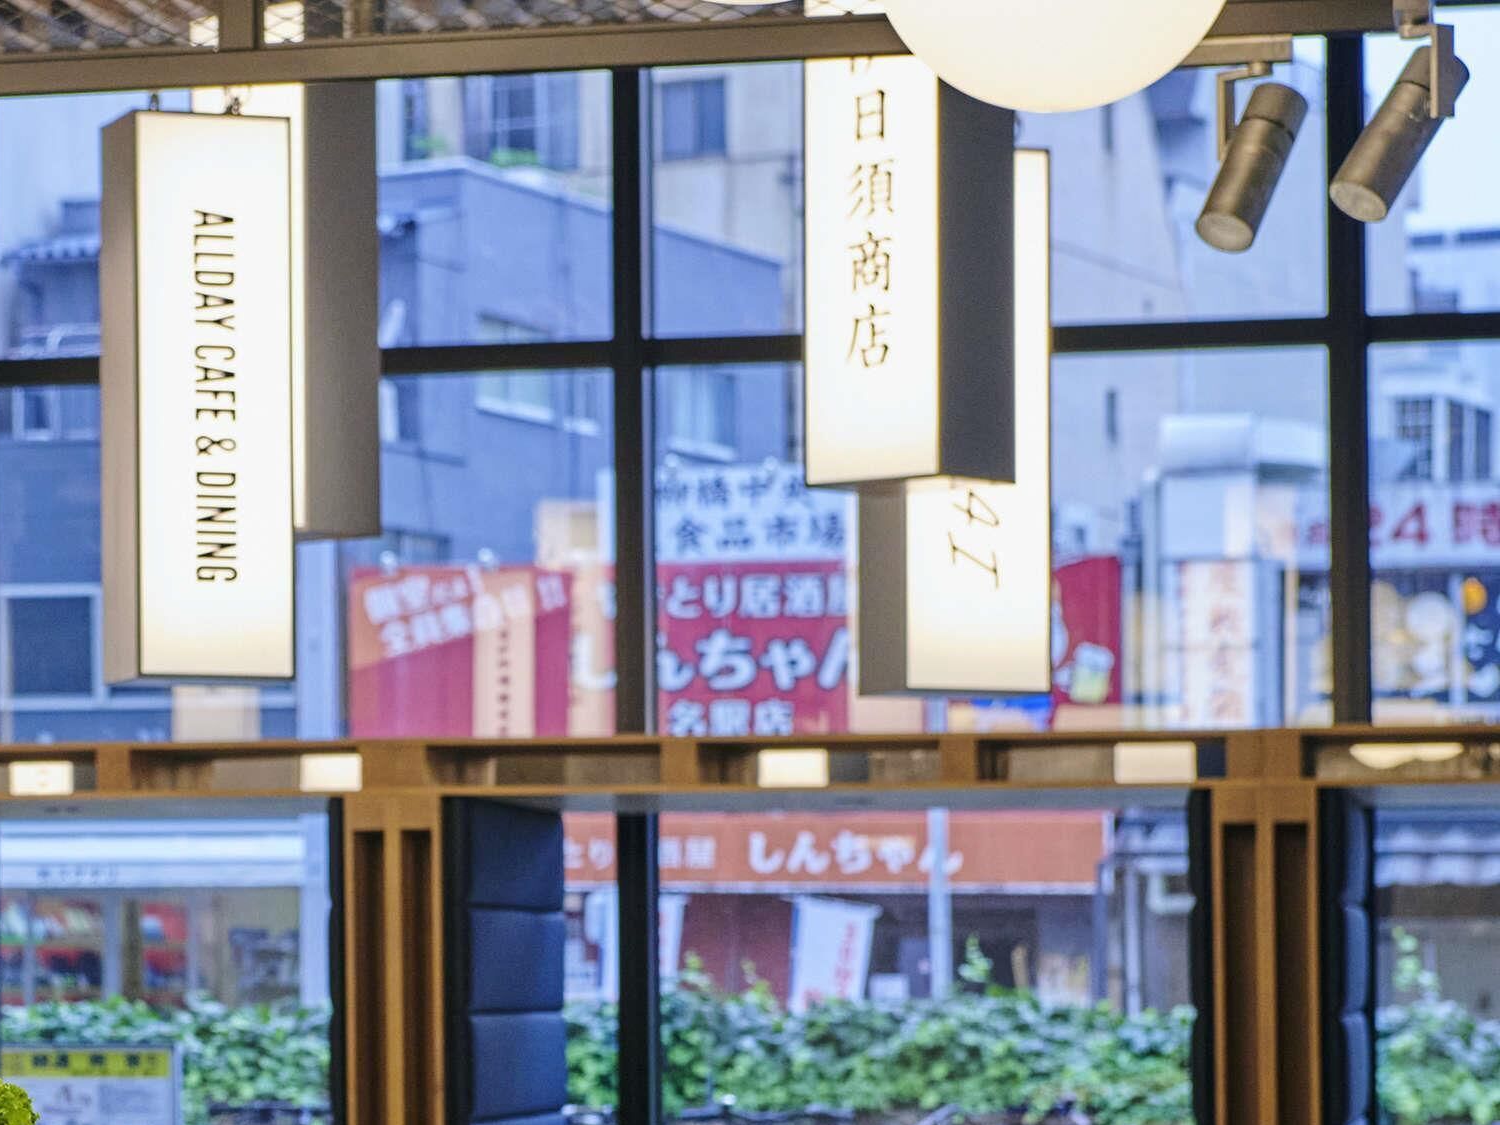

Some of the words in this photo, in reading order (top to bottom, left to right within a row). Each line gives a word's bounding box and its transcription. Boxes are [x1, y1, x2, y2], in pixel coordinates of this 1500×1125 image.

[846, 57, 897, 368] 日須商店
[194, 209, 236, 331] ALLDAY
[195, 344, 237, 421] CAFE
[195, 435, 237, 456] &
[196, 471, 239, 582] DINING
